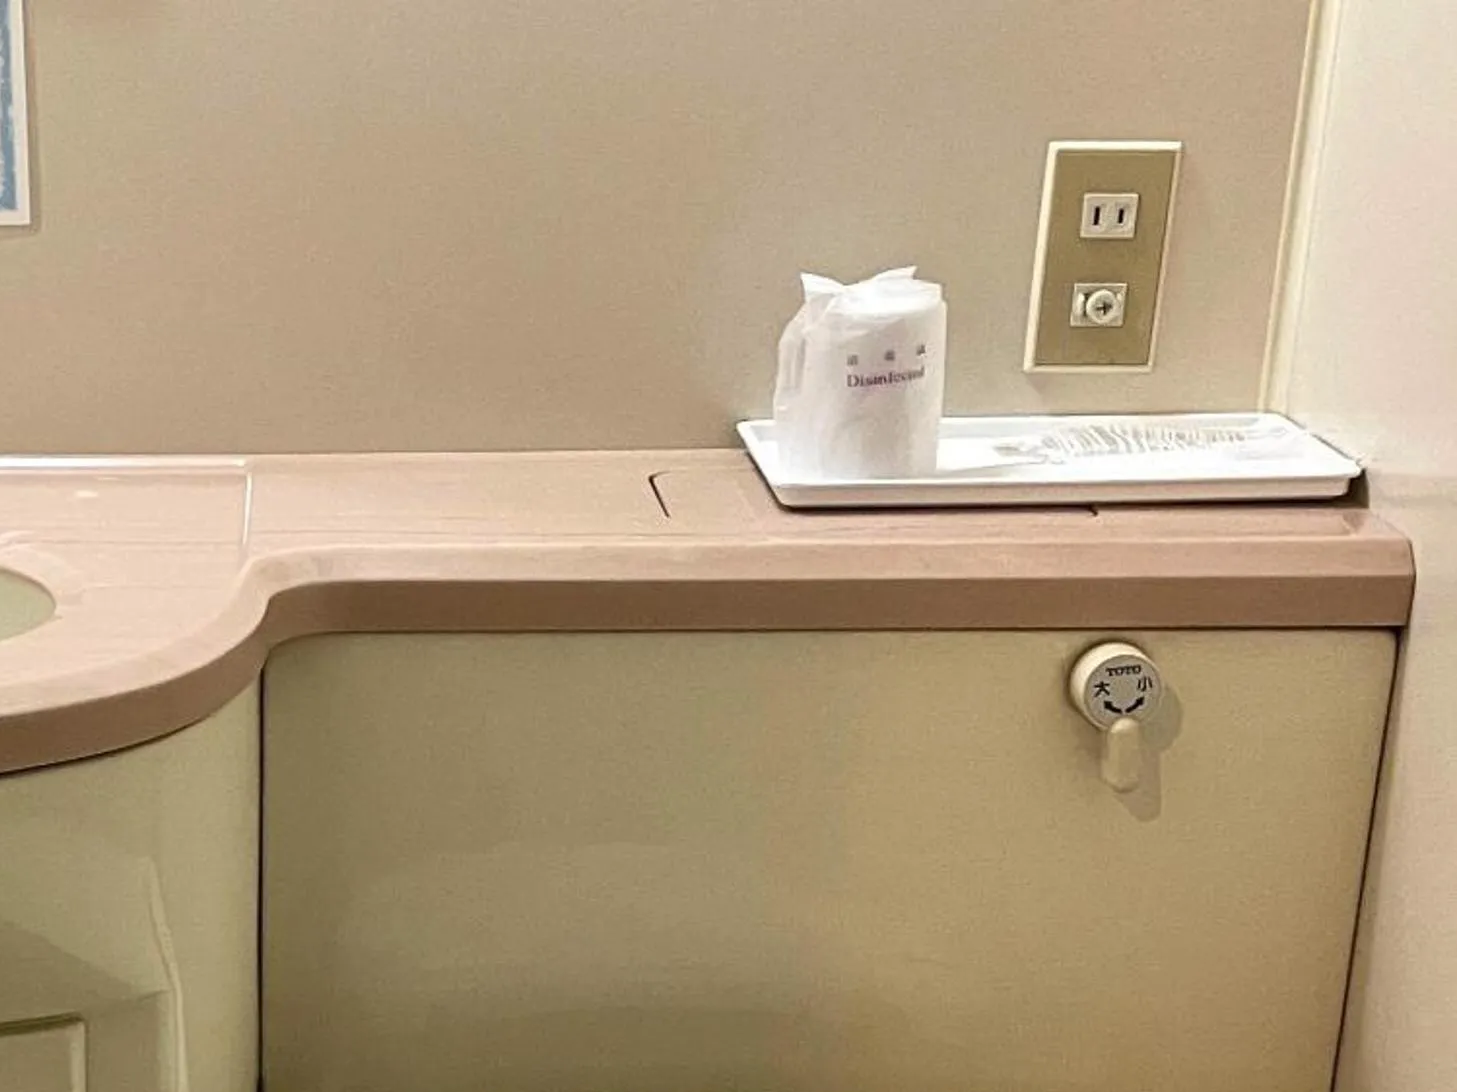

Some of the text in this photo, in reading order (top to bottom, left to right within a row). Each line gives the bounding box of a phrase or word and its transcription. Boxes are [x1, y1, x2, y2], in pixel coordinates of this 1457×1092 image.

[1105, 664, 1142, 677] TOTO
[1094, 681, 1110, 697] 大
[1137, 676, 1153, 692] 小
